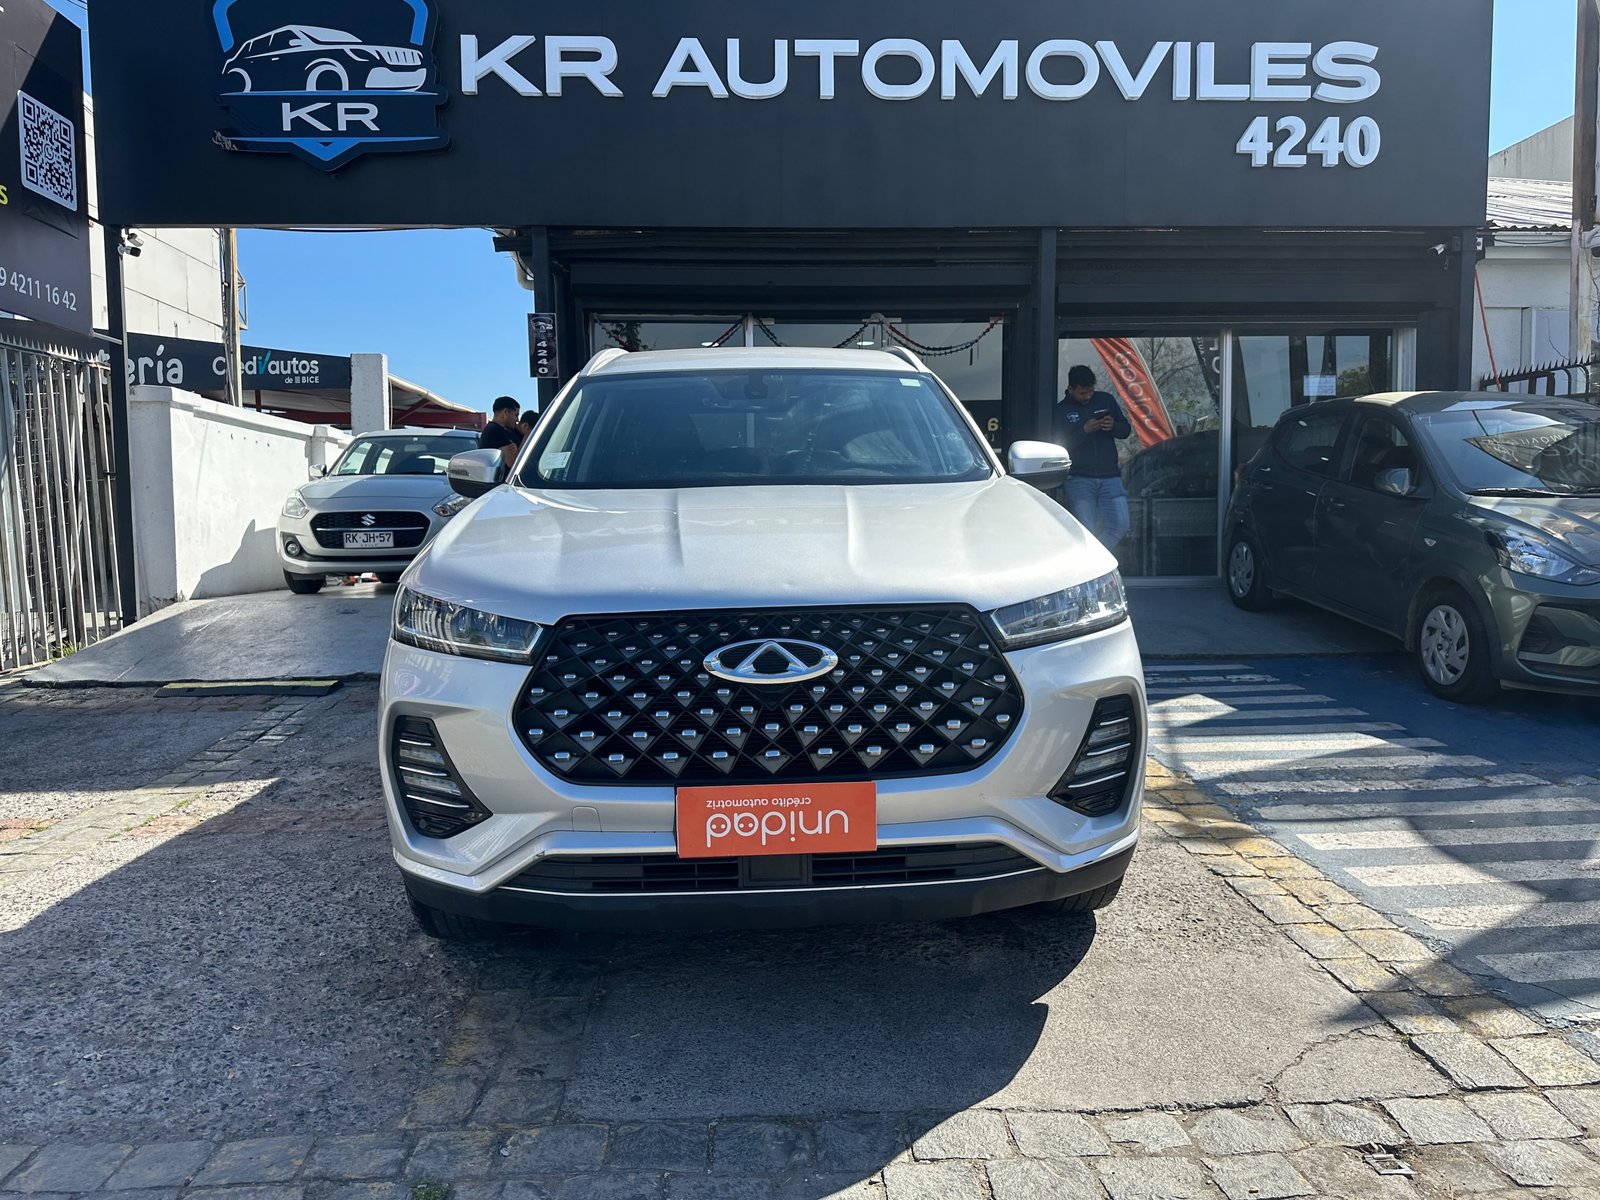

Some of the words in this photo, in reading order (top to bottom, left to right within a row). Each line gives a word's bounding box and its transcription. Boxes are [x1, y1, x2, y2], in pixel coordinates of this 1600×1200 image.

[460, 34, 624, 97] KR
[651, 37, 1381, 103] AUTOMOVILES
[281, 102, 380, 132] KR
[1236, 116, 1381, 168] 4240
[62, 290, 77, 312] 42
[284, 376, 294, 384] de
[301, 376, 320, 384] BICE
[706, 797, 768, 809] automotriz
[771, 797, 812, 806] crédito
[706, 809, 849, 848] unidad
